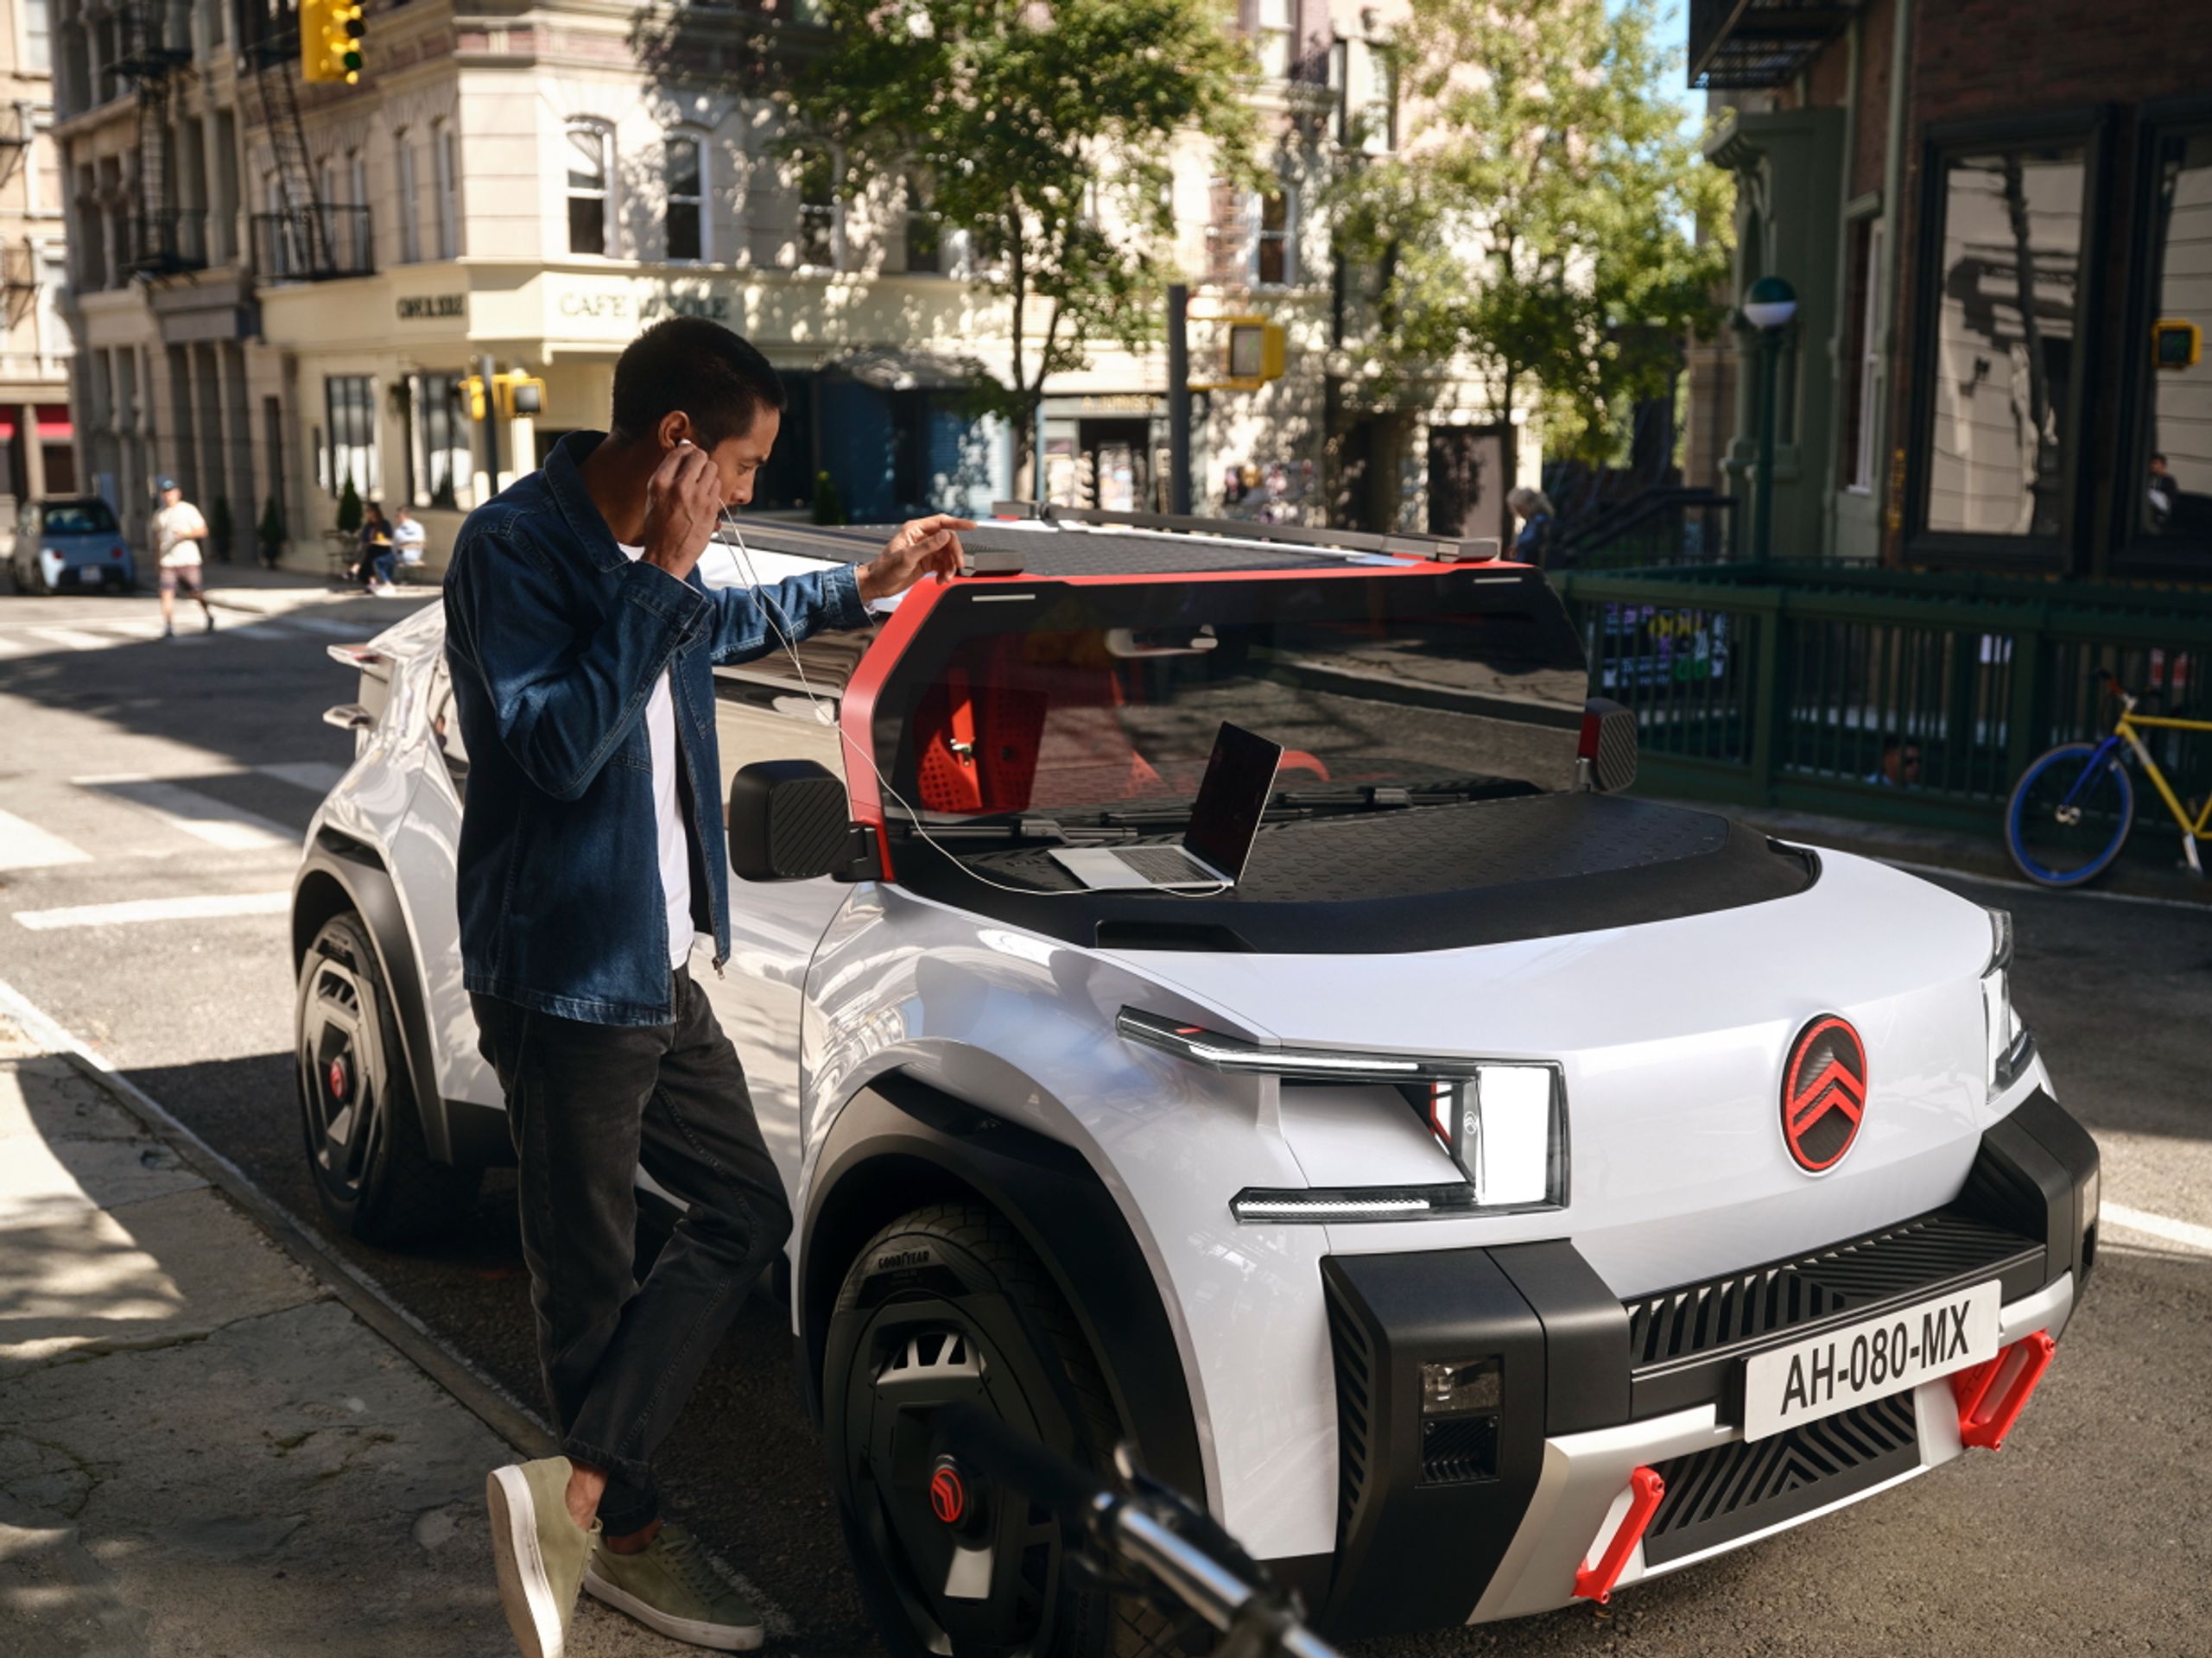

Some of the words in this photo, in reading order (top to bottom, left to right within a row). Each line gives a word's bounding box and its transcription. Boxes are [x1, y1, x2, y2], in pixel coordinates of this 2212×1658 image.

[558, 292, 629, 318] CAFE
[878, 1250, 930, 1269] GOODYEAR
[1780, 1300, 1970, 1415] AH-080-MX
